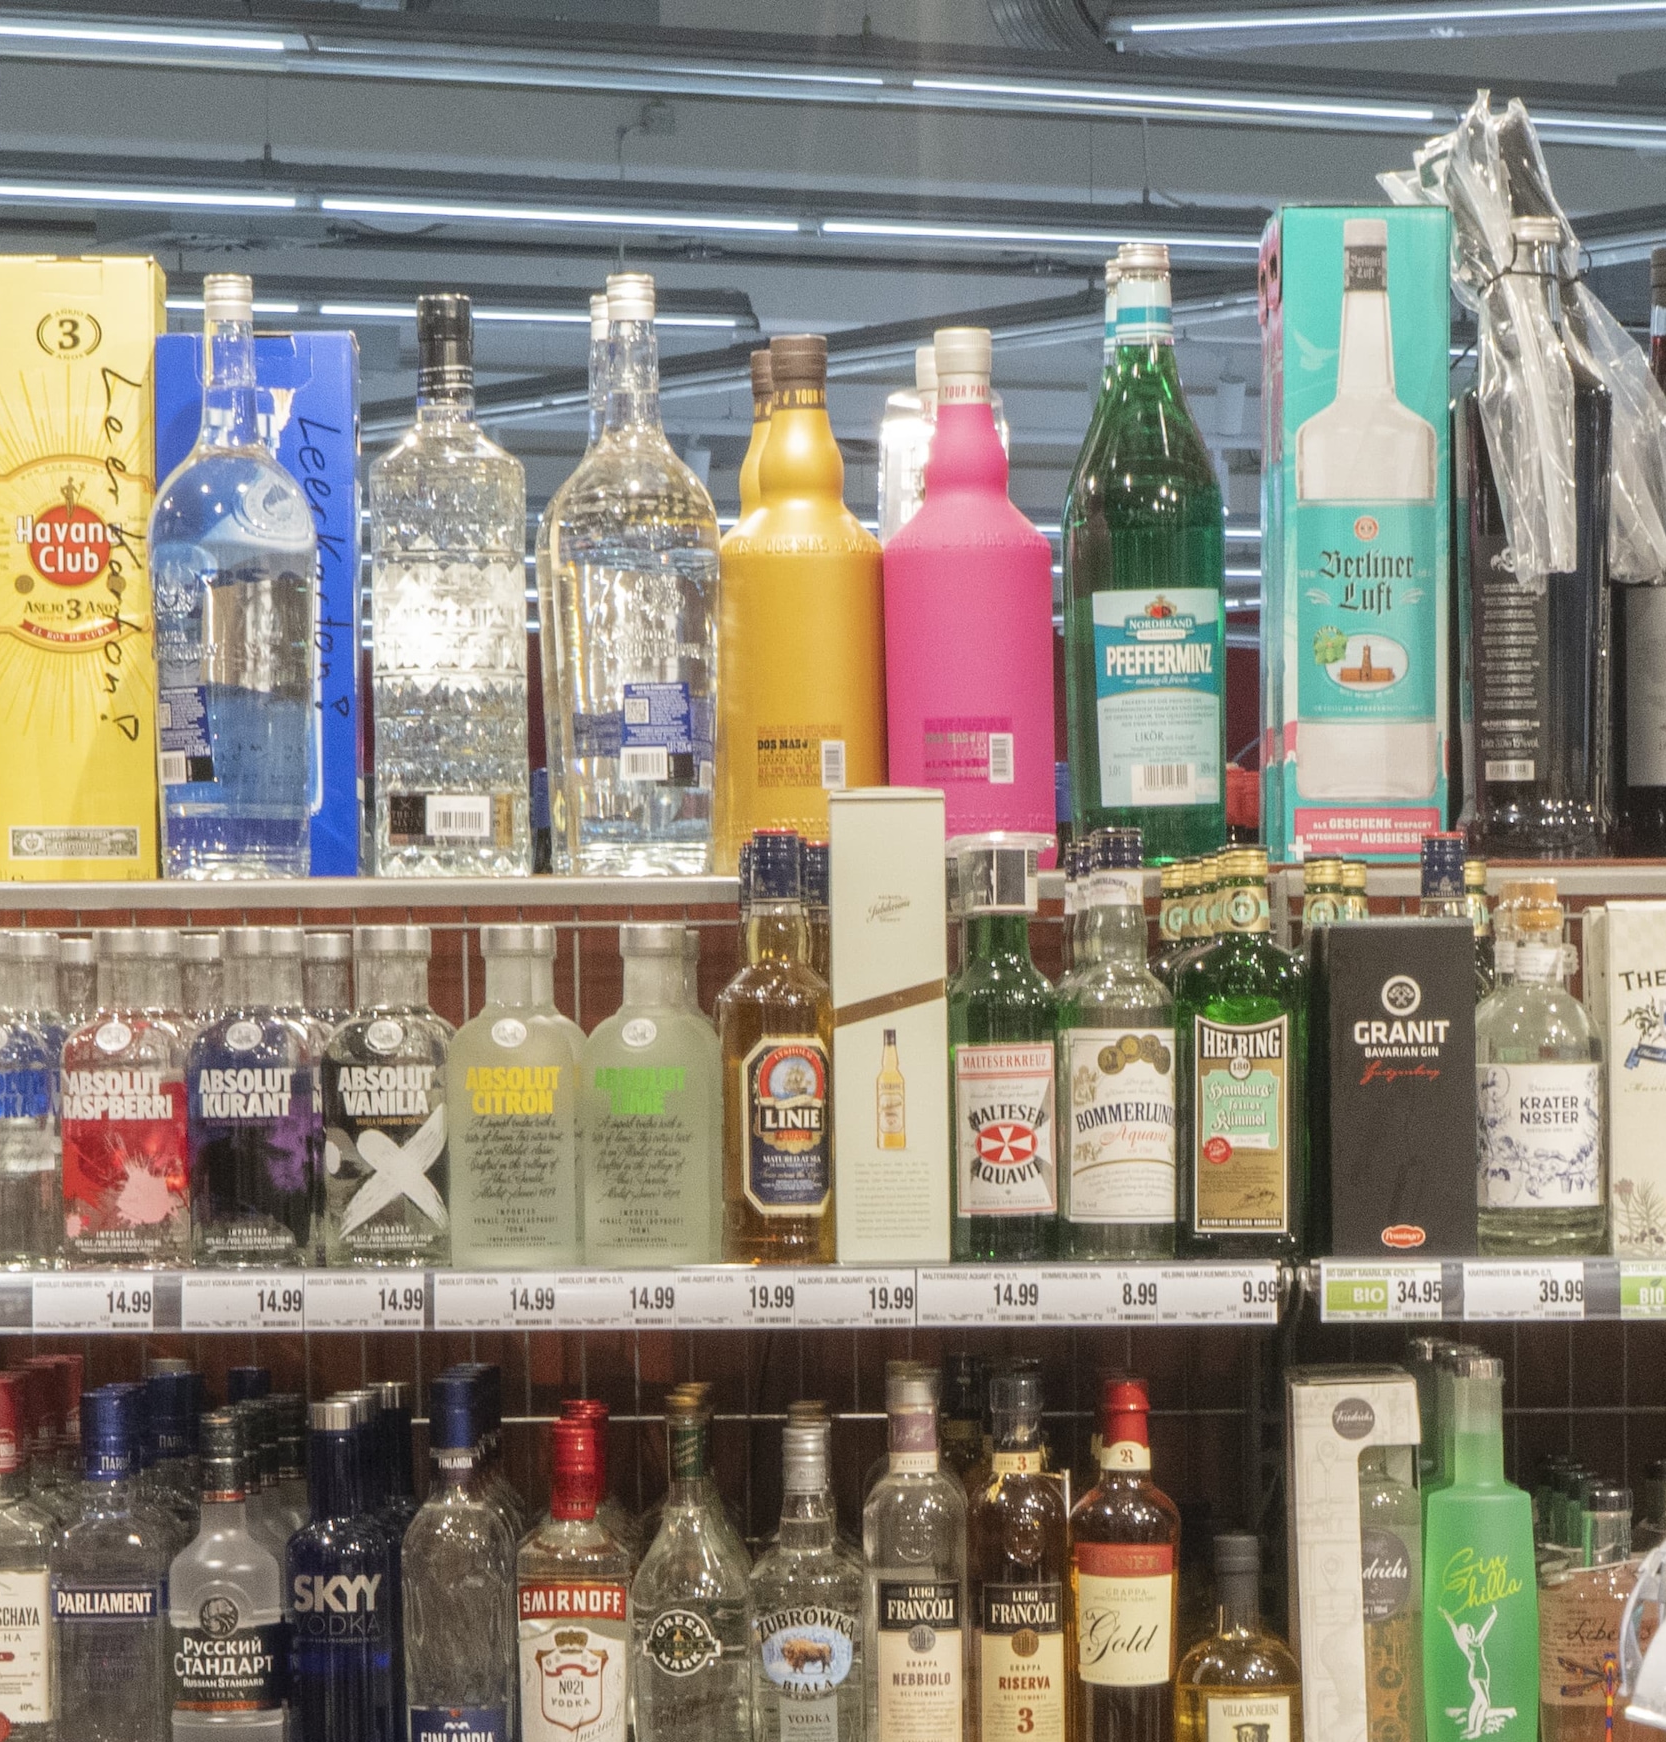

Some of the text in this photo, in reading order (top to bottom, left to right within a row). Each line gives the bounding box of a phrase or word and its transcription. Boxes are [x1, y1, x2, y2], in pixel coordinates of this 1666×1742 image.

[59, 319, 80, 349] 3
[297, 416, 341, 524] Leer
[17, 515, 123, 547] Havana
[39, 544, 101, 574] Club
[1319, 549, 1414, 579] Berliner
[1338, 585, 1394, 616] Luft
[1129, 618, 1192, 629] NORDBRAND
[1106, 643, 1212, 675] PFEFFERMINZ
[1619, 969, 1666, 992] THE
[1201, 1026, 1281, 1058] HELBING
[1354, 1021, 1450, 1044] GRANIT
[962, 1053, 1048, 1070] MALTESERKREUZ
[1365, 1047, 1439, 1057] BAVARIAN GIN
[68, 1070, 160, 1094] ABSOLUT
[198, 1068, 294, 1094] ABSOLUT
[339, 1066, 435, 1092] ABSOLUT
[466, 1067, 561, 1091] ABSOLUT
[62, 1094, 172, 1119] RASPBERRI
[202, 1093, 291, 1118] KURANT
[343, 1091, 429, 1116] VANILIA
[472, 1091, 554, 1114] CITRON
[1520, 1097, 1578, 1111] KRATER
[764, 1107, 820, 1130] LINIE
[970, 1104, 1046, 1130] MALTESER
[1520, 1112, 1578, 1125] NOSTER
[107, 1290, 152, 1314] 14.99
[630, 1287, 674, 1310] 14.99
[869, 1287, 915, 1310] 19.99
[1123, 1282, 1157, 1305] 8.99
[1352, 1287, 1384, 1303] BIO
[1539, 1281, 1584, 1302] 39.99
[1639, 1287, 1666, 1305] BIO
[57, 1592, 152, 1614] PARLIAMENT
[294, 1575, 381, 1613] SKYY
[521, 1591, 621, 1614] SMIRNOFF
[656, 1616, 704, 1638] GREEN
[183, 1636, 261, 1656] РУССКИЙ
[659, 1651, 702, 1670] MARK
[892, 1673, 950, 1687] NEBBIOLO
[999, 1676, 1051, 1690] RISERVA
[788, 1715, 830, 1723] VODKA
[1016, 1708, 1035, 1734] 3
